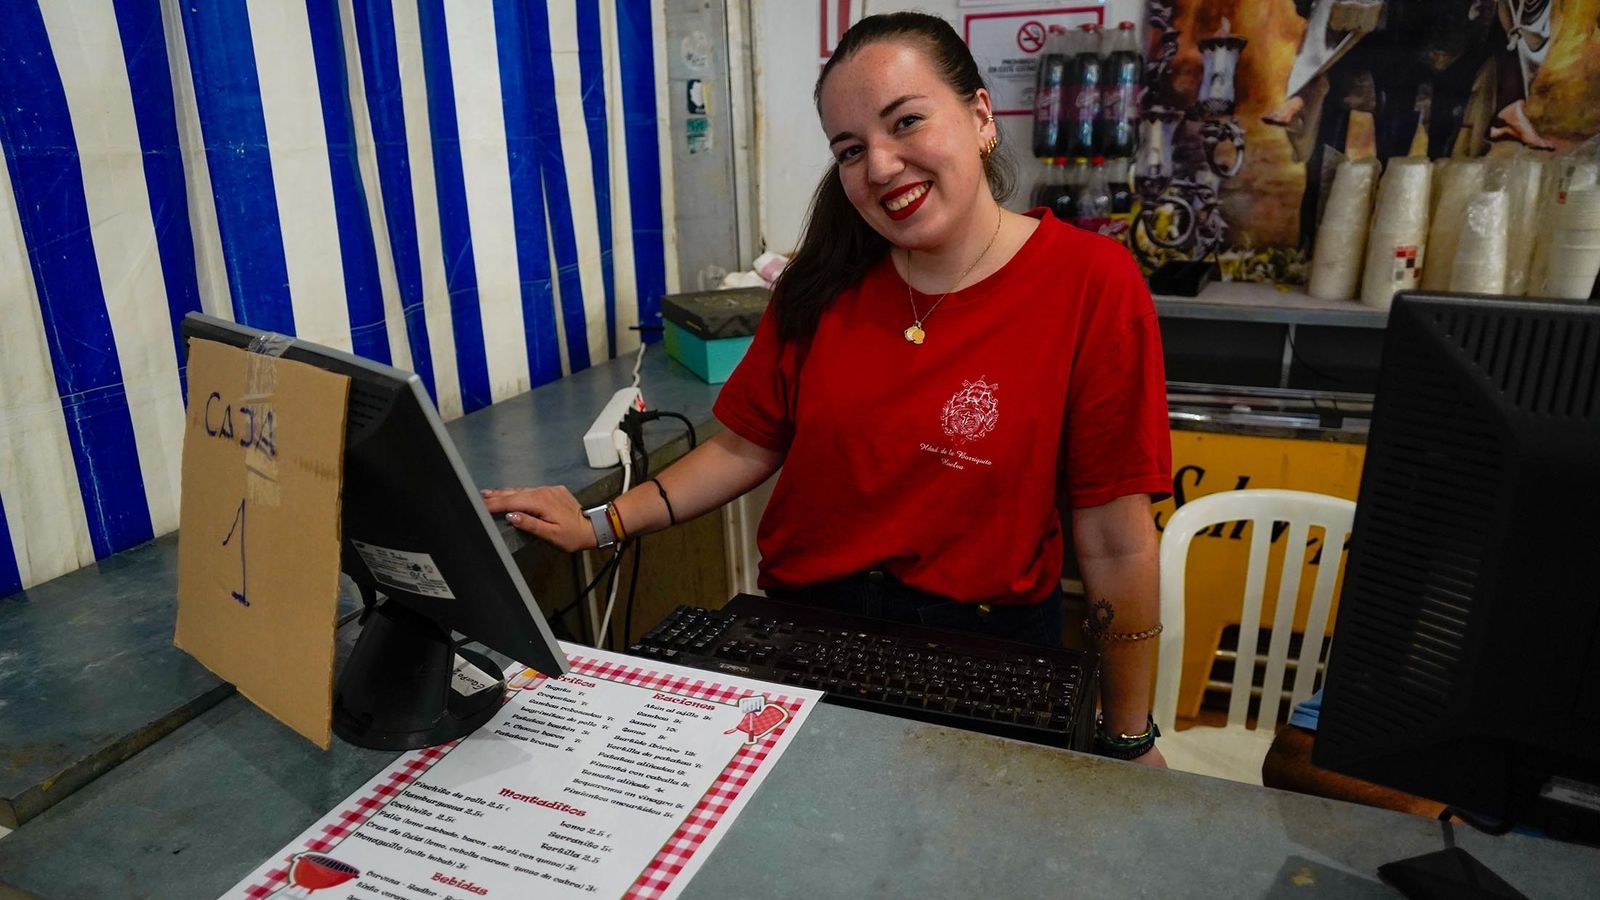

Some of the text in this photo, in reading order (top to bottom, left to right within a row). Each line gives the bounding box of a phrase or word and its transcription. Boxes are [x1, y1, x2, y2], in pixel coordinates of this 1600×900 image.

[204, 391, 277, 458] CAJA
[222, 498, 250, 607] 1
[528, 698, 559, 710] Gambas
[652, 692, 716, 711] Raciones
[512, 713, 546, 726] Patatas
[636, 711, 669, 722] Gambas
[665, 707, 676, 715] al
[676, 709, 700, 719] ajillo
[577, 720, 598, 728] pollo
[621, 727, 646, 736] Queso
[494, 729, 529, 741] Patatas
[529, 737, 560, 749] bravas
[598, 751, 635, 765] Patatas
[606, 743, 641, 756] Tortilla
[653, 754, 692, 767] patatas
[628, 770, 645, 778] con
[402, 790, 464, 812] Hamburguesa
[412, 781, 451, 796] Pinchito
[463, 794, 487, 806] pollo
[498, 787, 588, 817] Montaditos
[624, 790, 637, 798] en
[389, 800, 433, 817] Cochinito
[378, 810, 402, 821] Palio
[461, 834, 487, 847] bacon
[518, 851, 535, 860] con
[560, 820, 586, 832] Lomo
[353, 831, 404, 851] Monaguillo
[548, 831, 600, 850] Serranito
[389, 828, 401, 836] de
[449, 845, 480, 859] cebolla
[513, 865, 540, 877] queso
[540, 872, 552, 880] de
[540, 842, 581, 859] Tortilla
[430, 871, 489, 897] Bebidas
